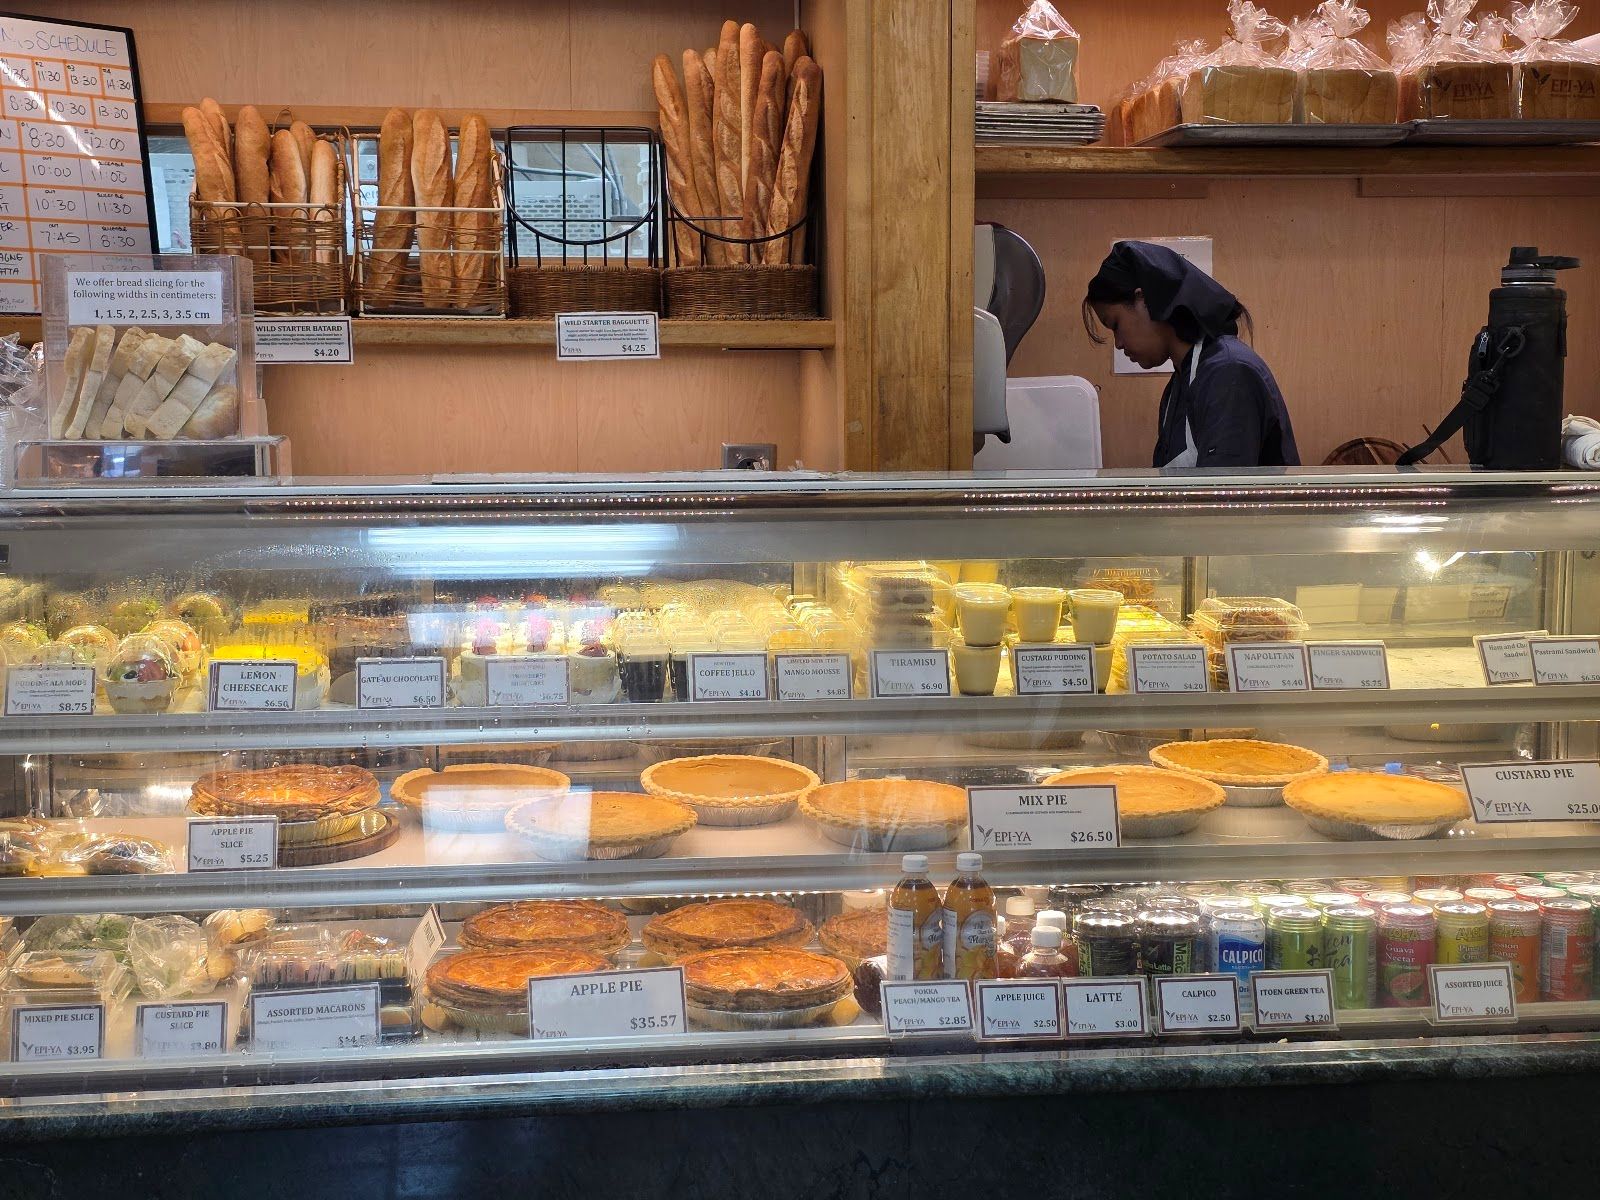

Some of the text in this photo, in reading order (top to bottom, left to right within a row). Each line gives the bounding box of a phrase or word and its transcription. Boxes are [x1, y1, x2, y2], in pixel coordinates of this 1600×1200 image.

[36, 30, 118, 57] SCHEDULE
[1454, 82, 1495, 97] EPI-YA
[1551, 79, 1595, 95] EPI-YA
[9, 95, 39, 112] 8:30
[29, 127, 65, 148] 8:30
[32, 164, 73, 178] 10:00
[35, 198, 76, 212] 10:30
[97, 202, 132, 215] 11:30
[40, 231, 81, 244] 7:45
[100, 234, 136, 248] 8:30
[76, 277, 206, 290] We offer bread slicing for the
[73, 289, 217, 301] following widths in centimeters:
[94, 309, 211, 321] 1, 1.5, 2, 2.5, 3, 3.5 cm
[612, 318, 650, 326] BAGGUETTE
[313, 348, 340, 358] $4.20
[621, 344, 646, 353] $4.25
[1142, 653, 1172, 661] POTATO
[1243, 652, 1295, 661] NAPOLITAN
[1313, 649, 1382, 657] FINGER SANDWICH
[1534, 648, 1596, 657] Pastrami Sandwich
[889, 658, 937, 667] TIRAMISU
[1021, 654, 1053, 662] CUSTARD
[240, 671, 277, 680] LEMON
[700, 669, 756, 678] COFFEE JELLO
[361, 674, 440, 684] GATEAU CHOCOLATE
[1062, 677, 1088, 687] $4.50
[1281, 679, 1303, 687] $4.40
[1360, 679, 1383, 687] $5.75
[223, 683, 289, 693] CHEESECAKE
[921, 682, 943, 690] $6.90
[739, 689, 761, 697] $4.10
[264, 699, 290, 708] $6.50
[412, 695, 437, 703] $6.50
[59, 702, 88, 712] $8.75
[1495, 768, 1574, 781] CUSTARD PIE
[1018, 794, 1068, 806] MIX PIE
[1494, 802, 1532, 813] EPI-YA
[211, 827, 254, 836] APPLE PIE
[994, 831, 1032, 843] EPI-YA
[1070, 830, 1114, 844] $26.50
[220, 840, 244, 849] SLICE
[240, 853, 269, 864] $5.25
[1385, 944, 1415, 954] Guava
[1221, 948, 1263, 965] CALPICO
[1385, 953, 1416, 963] Nectar
[571, 980, 643, 997] APPLE PIE
[1444, 978, 1503, 989] ASSORTED JUICE
[914, 988, 939, 996] POKKA
[1181, 989, 1217, 999] CALPICO
[1260, 986, 1325, 997] ITOEN GREEN TEA
[894, 996, 961, 1006] PEACH/MANGO TEA
[994, 992, 1046, 1002] APPLE JUICE
[1085, 992, 1123, 1004] LATTE
[155, 1009, 210, 1020] CUSTARD PIE
[267, 1003, 366, 1018] ASSORTED MACARONS
[1269, 1011, 1293, 1020] EPI-YA
[1484, 1005, 1510, 1016] $0.96
[25, 1012, 95, 1024] MIXED PIE SLICE
[938, 1015, 967, 1026] $2.85
[1175, 1013, 1199, 1021] EPI-YA
[1207, 1013, 1231, 1024] $2.50
[1304, 1013, 1330, 1023] $1.20
[170, 1022, 194, 1031] SLICE
[630, 1014, 677, 1031] $35.57
[997, 1020, 1021, 1029] EPI-YA
[1033, 1018, 1057, 1029] $2.50
[1114, 1019, 1138, 1030] $3.00
[35, 1045, 63, 1054] EPI-YA
[67, 1044, 96, 1056] $3.95
